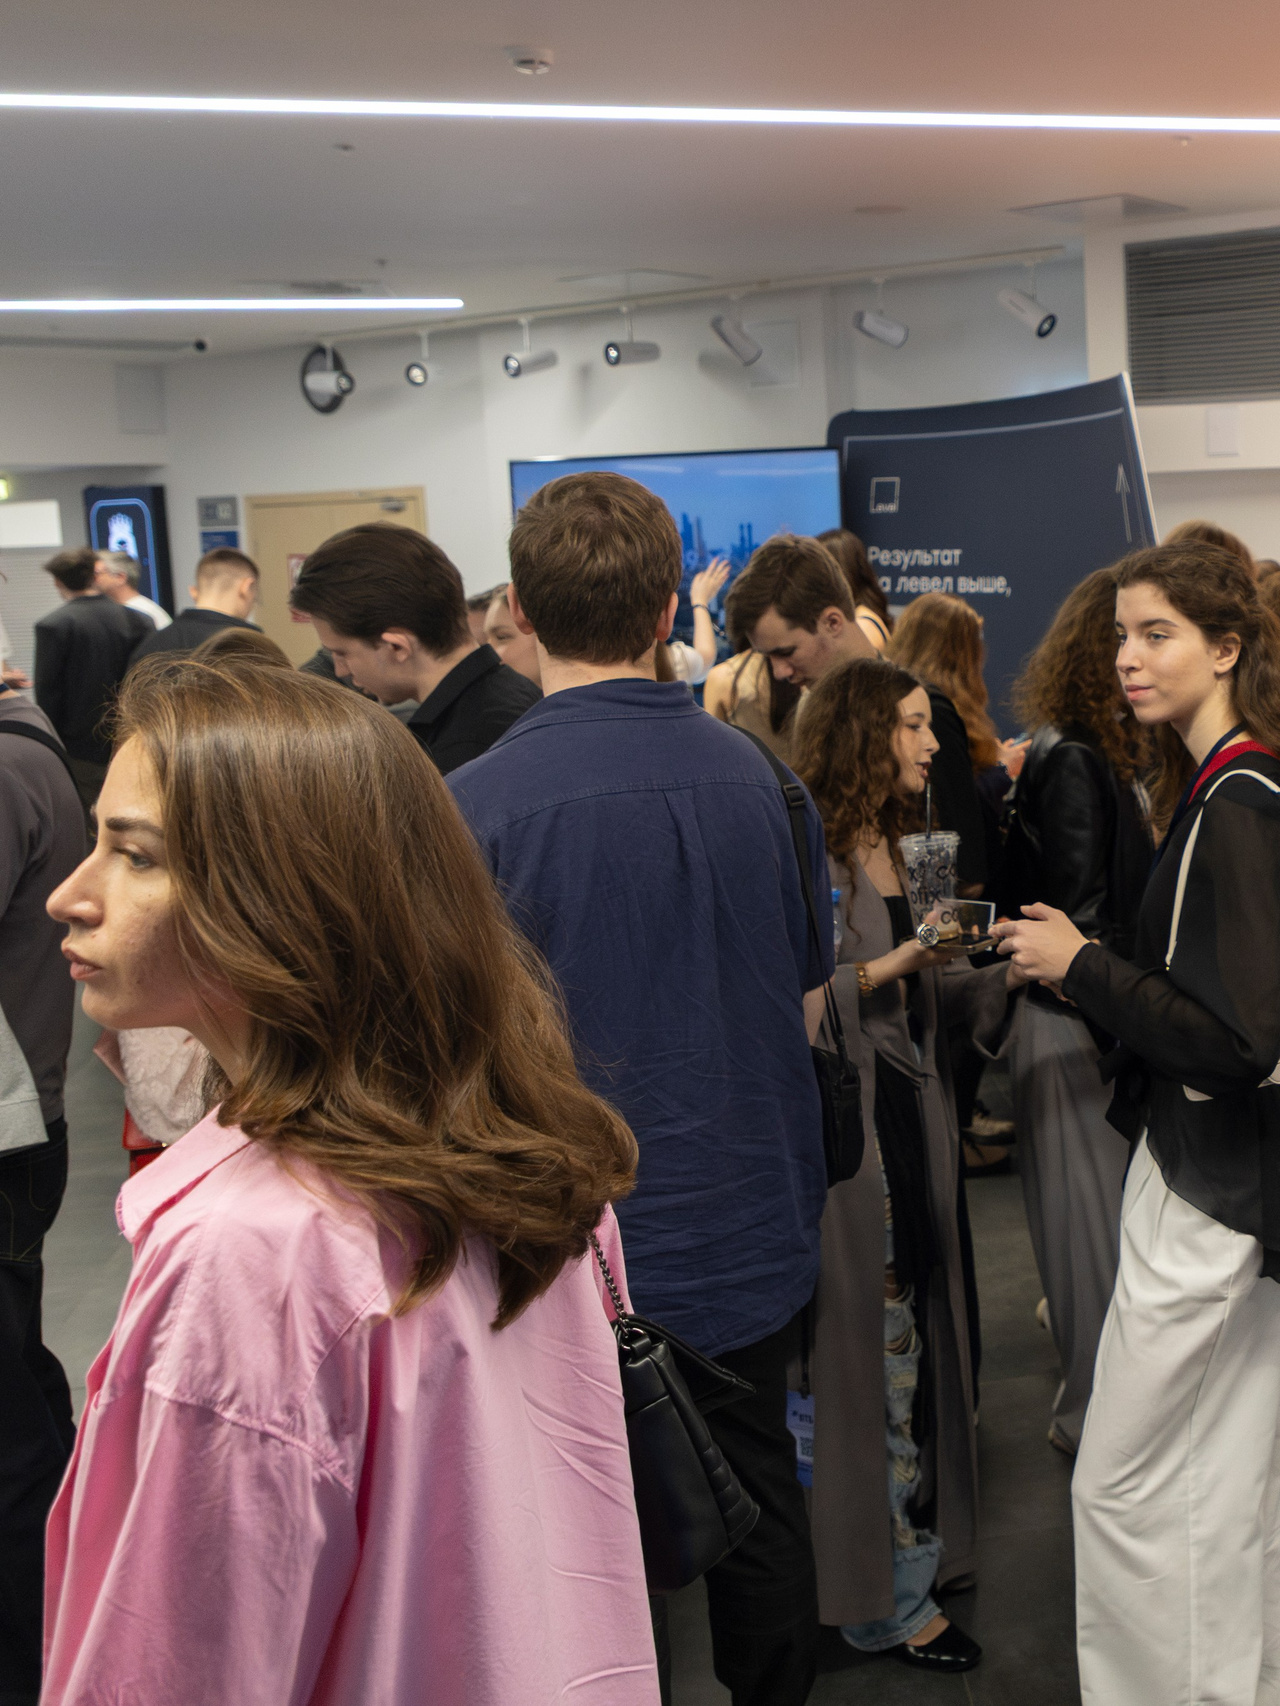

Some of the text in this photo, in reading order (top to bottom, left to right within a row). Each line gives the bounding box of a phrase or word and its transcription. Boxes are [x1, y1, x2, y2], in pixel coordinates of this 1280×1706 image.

[867, 546, 962, 572] Результат
[895, 576, 953, 592] левел
[957, 576, 1011, 597] выше,
